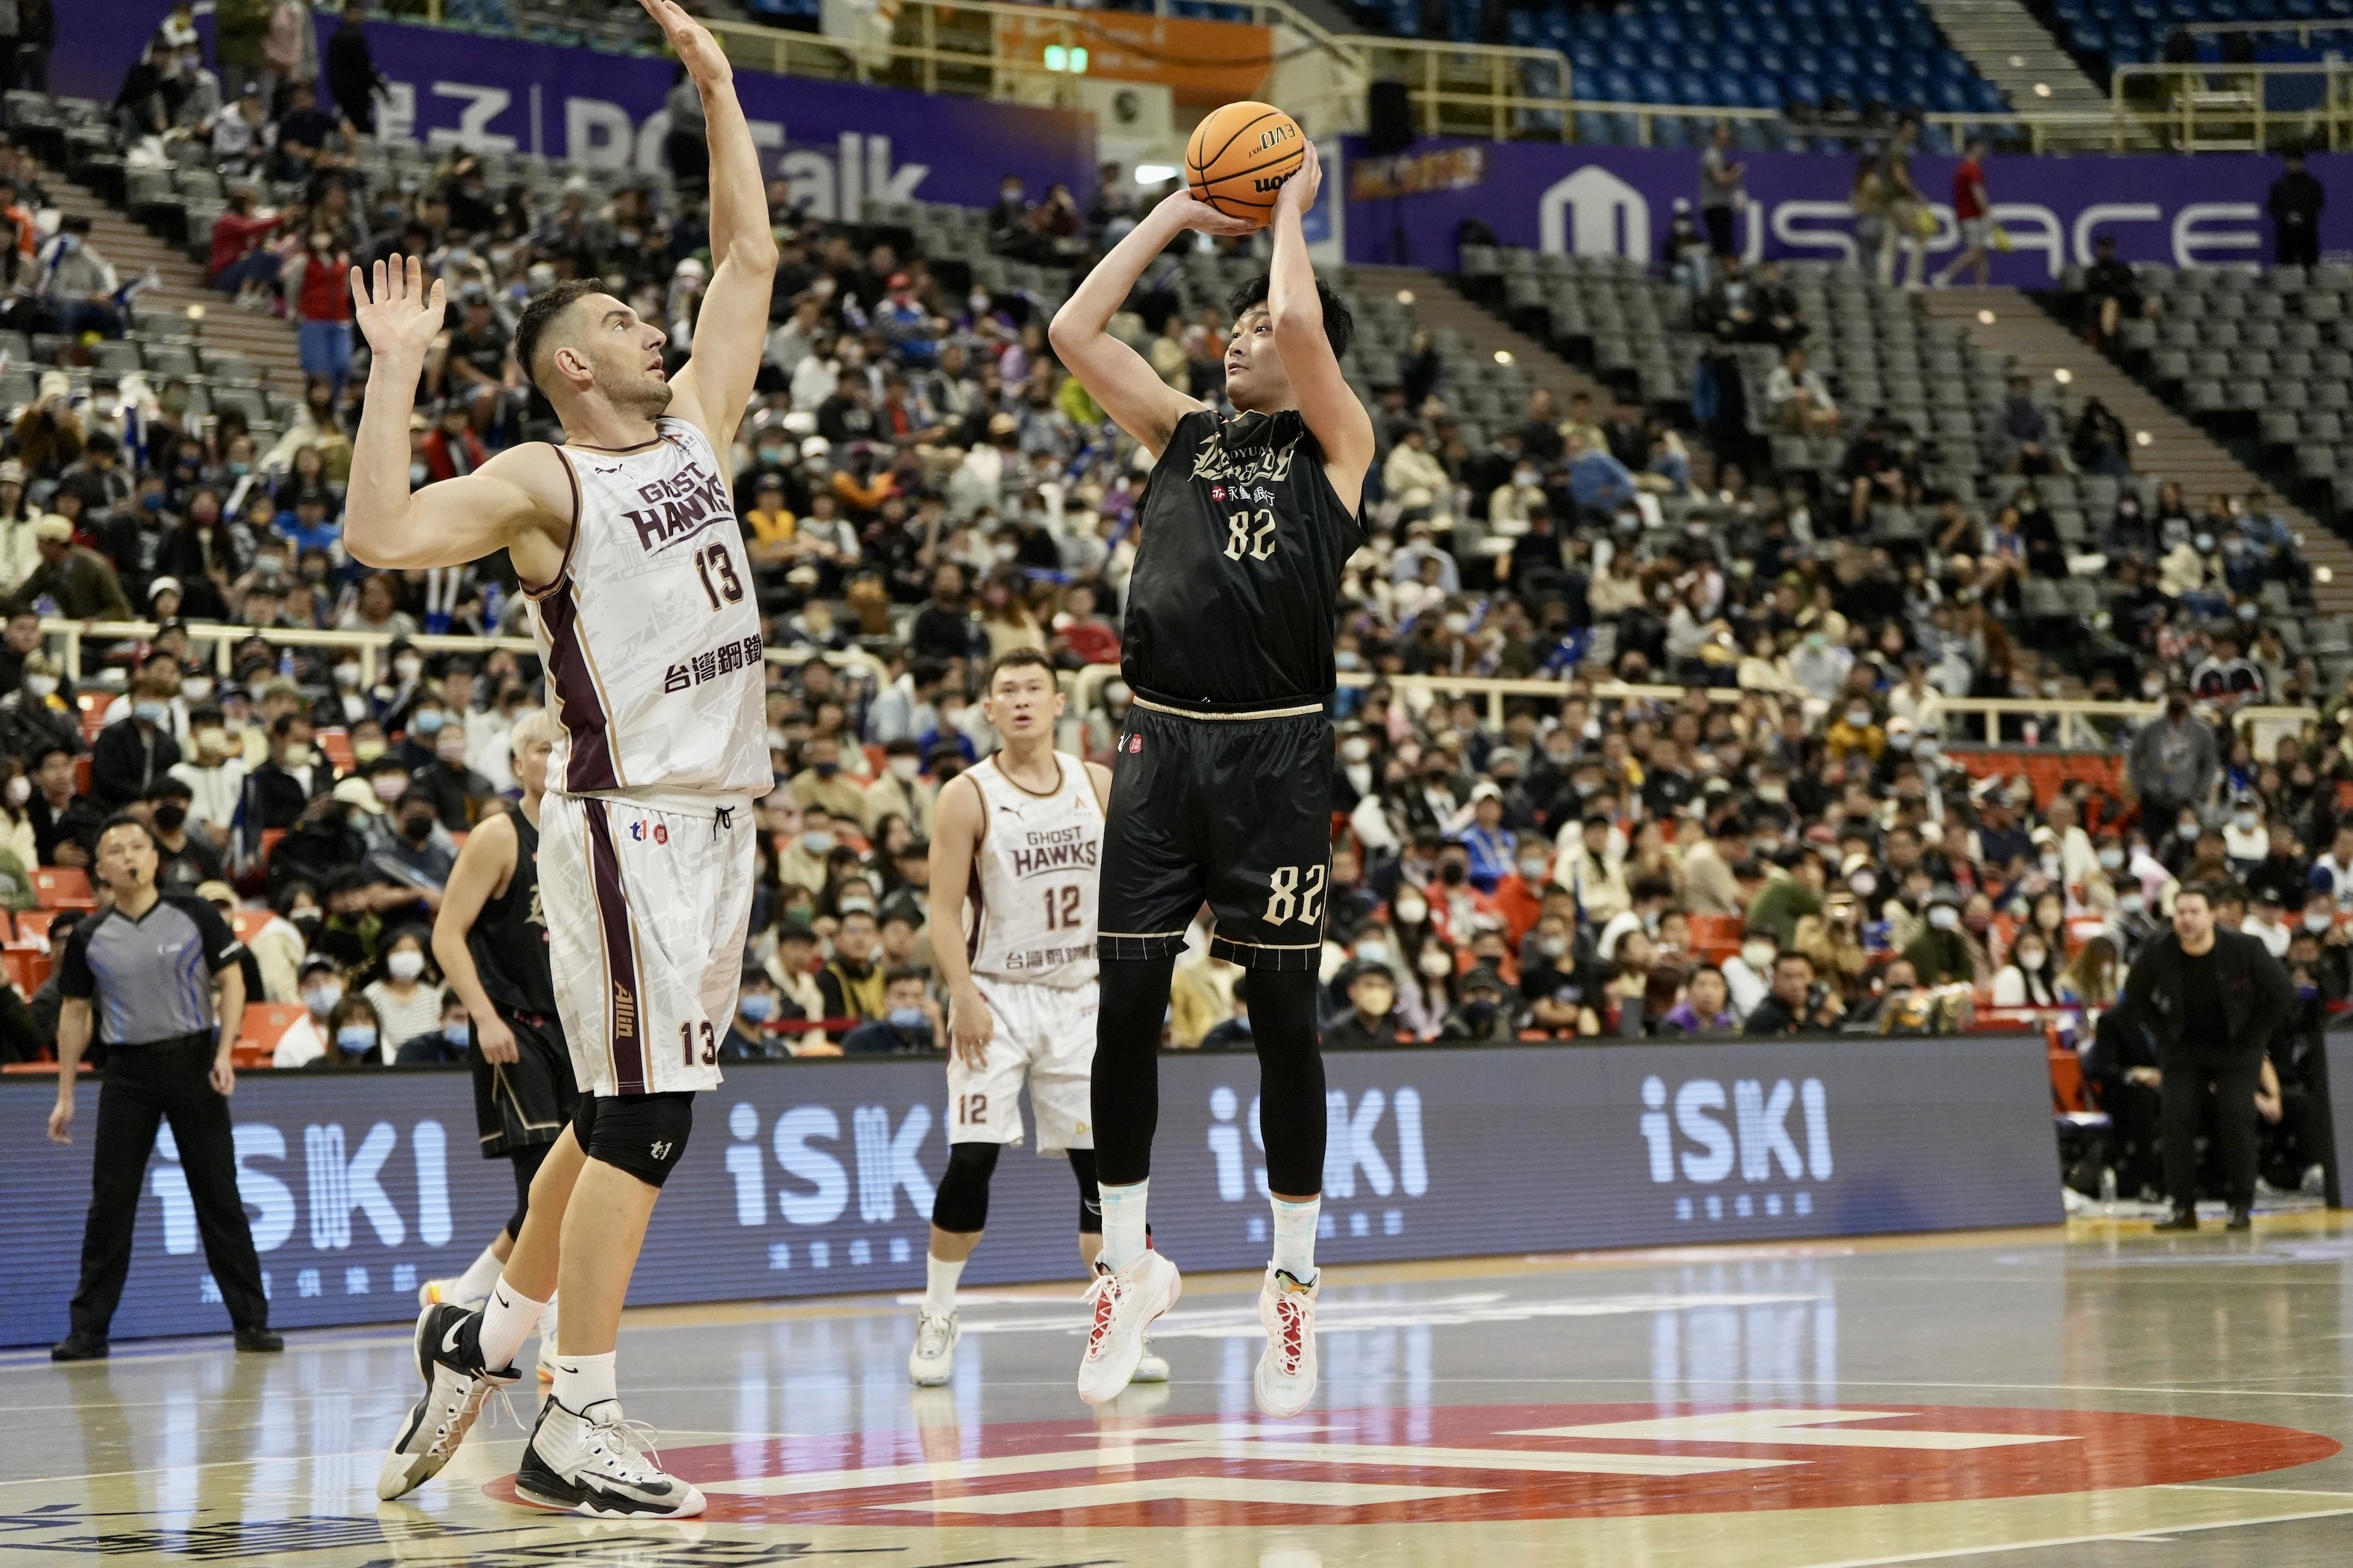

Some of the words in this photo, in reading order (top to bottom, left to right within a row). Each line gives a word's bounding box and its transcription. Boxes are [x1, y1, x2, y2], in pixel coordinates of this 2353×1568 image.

[1259, 124, 1296, 151] EVO
[1224, 509, 1276, 562] 82
[694, 542, 745, 612] 13
[1009, 840, 1096, 877] HAWKS
[1027, 826, 1081, 845] GHOST
[1043, 885, 1081, 931] 12
[1262, 865, 1325, 926] 82
[679, 1020, 716, 1067] 13
[959, 1094, 986, 1125] 12
[1641, 1076, 1833, 1183] iSKI
[725, 1102, 949, 1226] iSK
[1208, 1085, 1428, 1202] iKI
